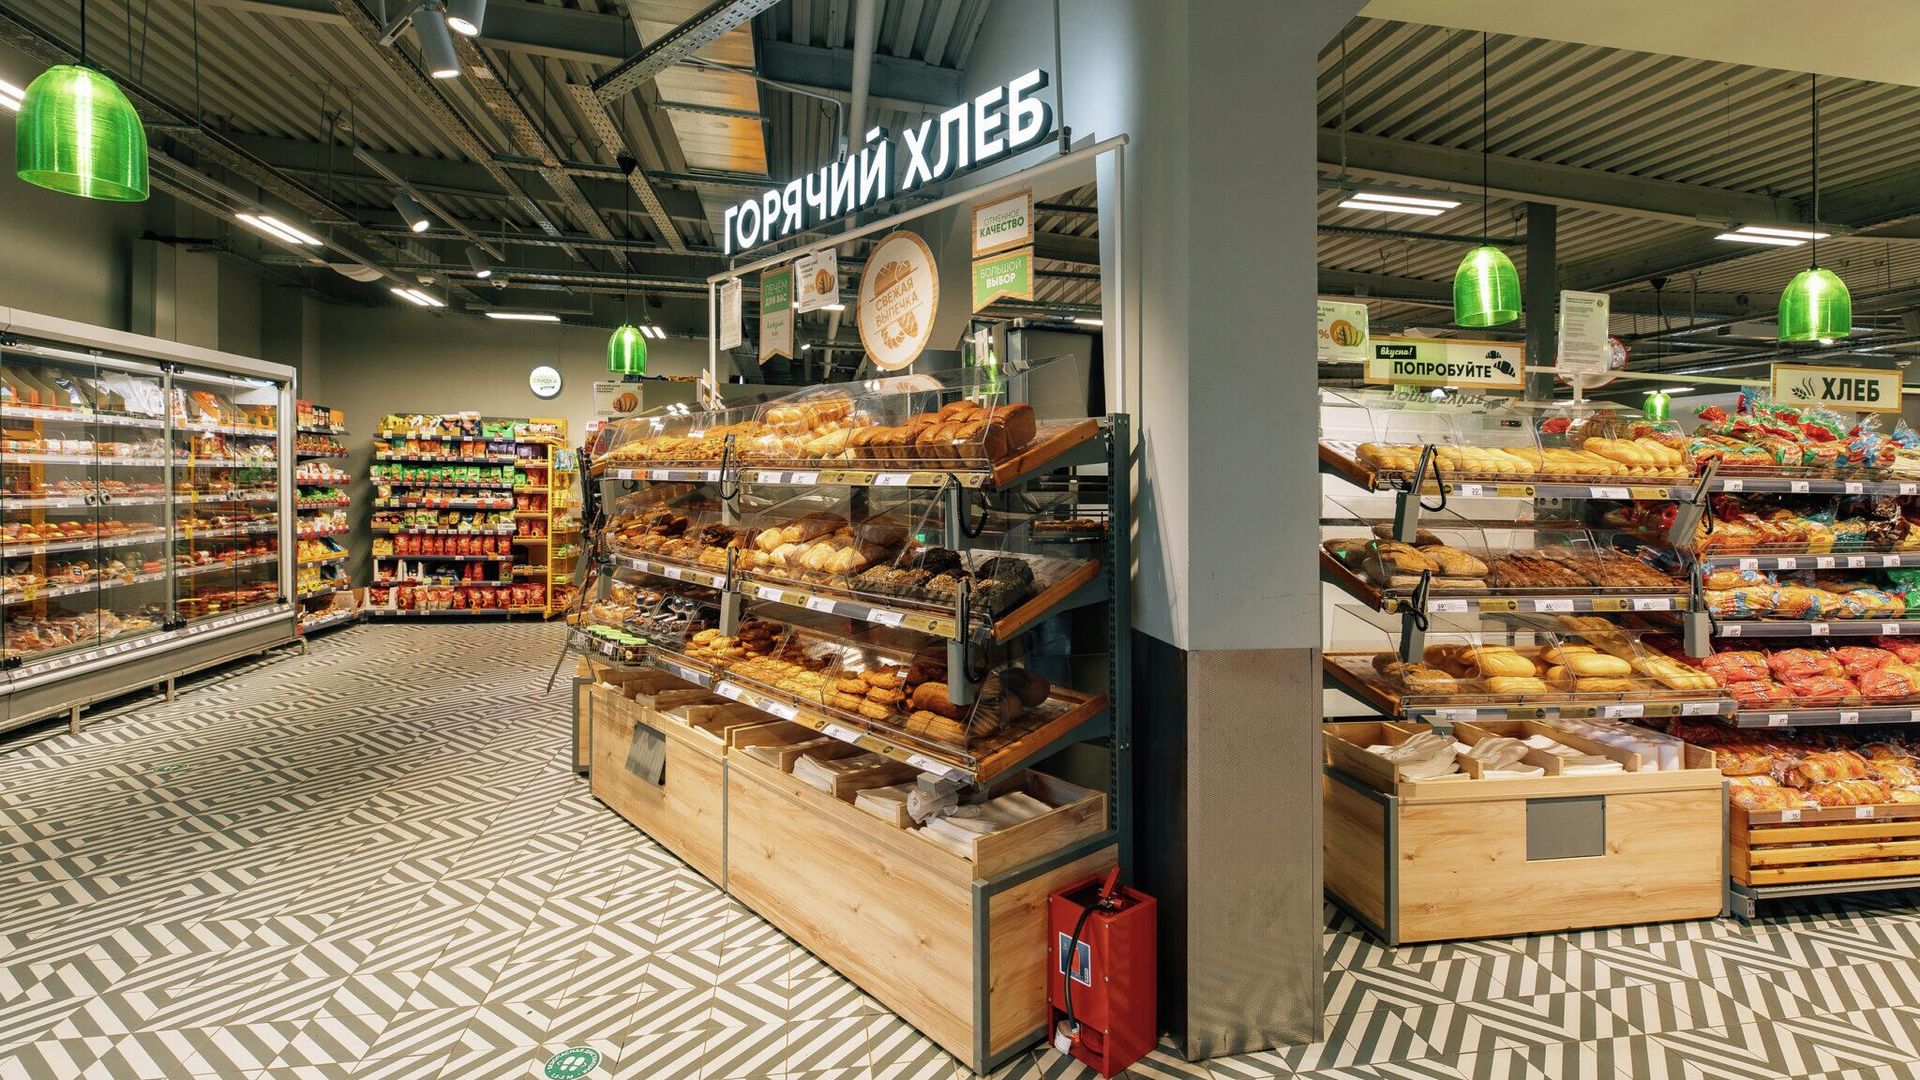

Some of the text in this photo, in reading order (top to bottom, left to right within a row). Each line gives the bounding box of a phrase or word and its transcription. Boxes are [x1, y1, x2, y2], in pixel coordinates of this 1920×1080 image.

[724, 68, 1050, 256] ГОРЯЧИЙ ХЛЕБ
[979, 216, 1025, 238] КАЧЕСТВО
[983, 208, 1021, 226] ОТМЕННОЕ
[980, 257, 1022, 279] БОЛЬШОЙ
[986, 272, 1016, 288] ВЫБОР
[876, 277, 914, 311] СВЕЖАЯ
[875, 291, 919, 328] ВЫПЕЧКА
[1380, 346, 1413, 358] Вкусно!
[1394, 361, 1492, 378] ПОПРОБУЙТЕ
[1821, 377, 1880, 402] ХЛЕБ
